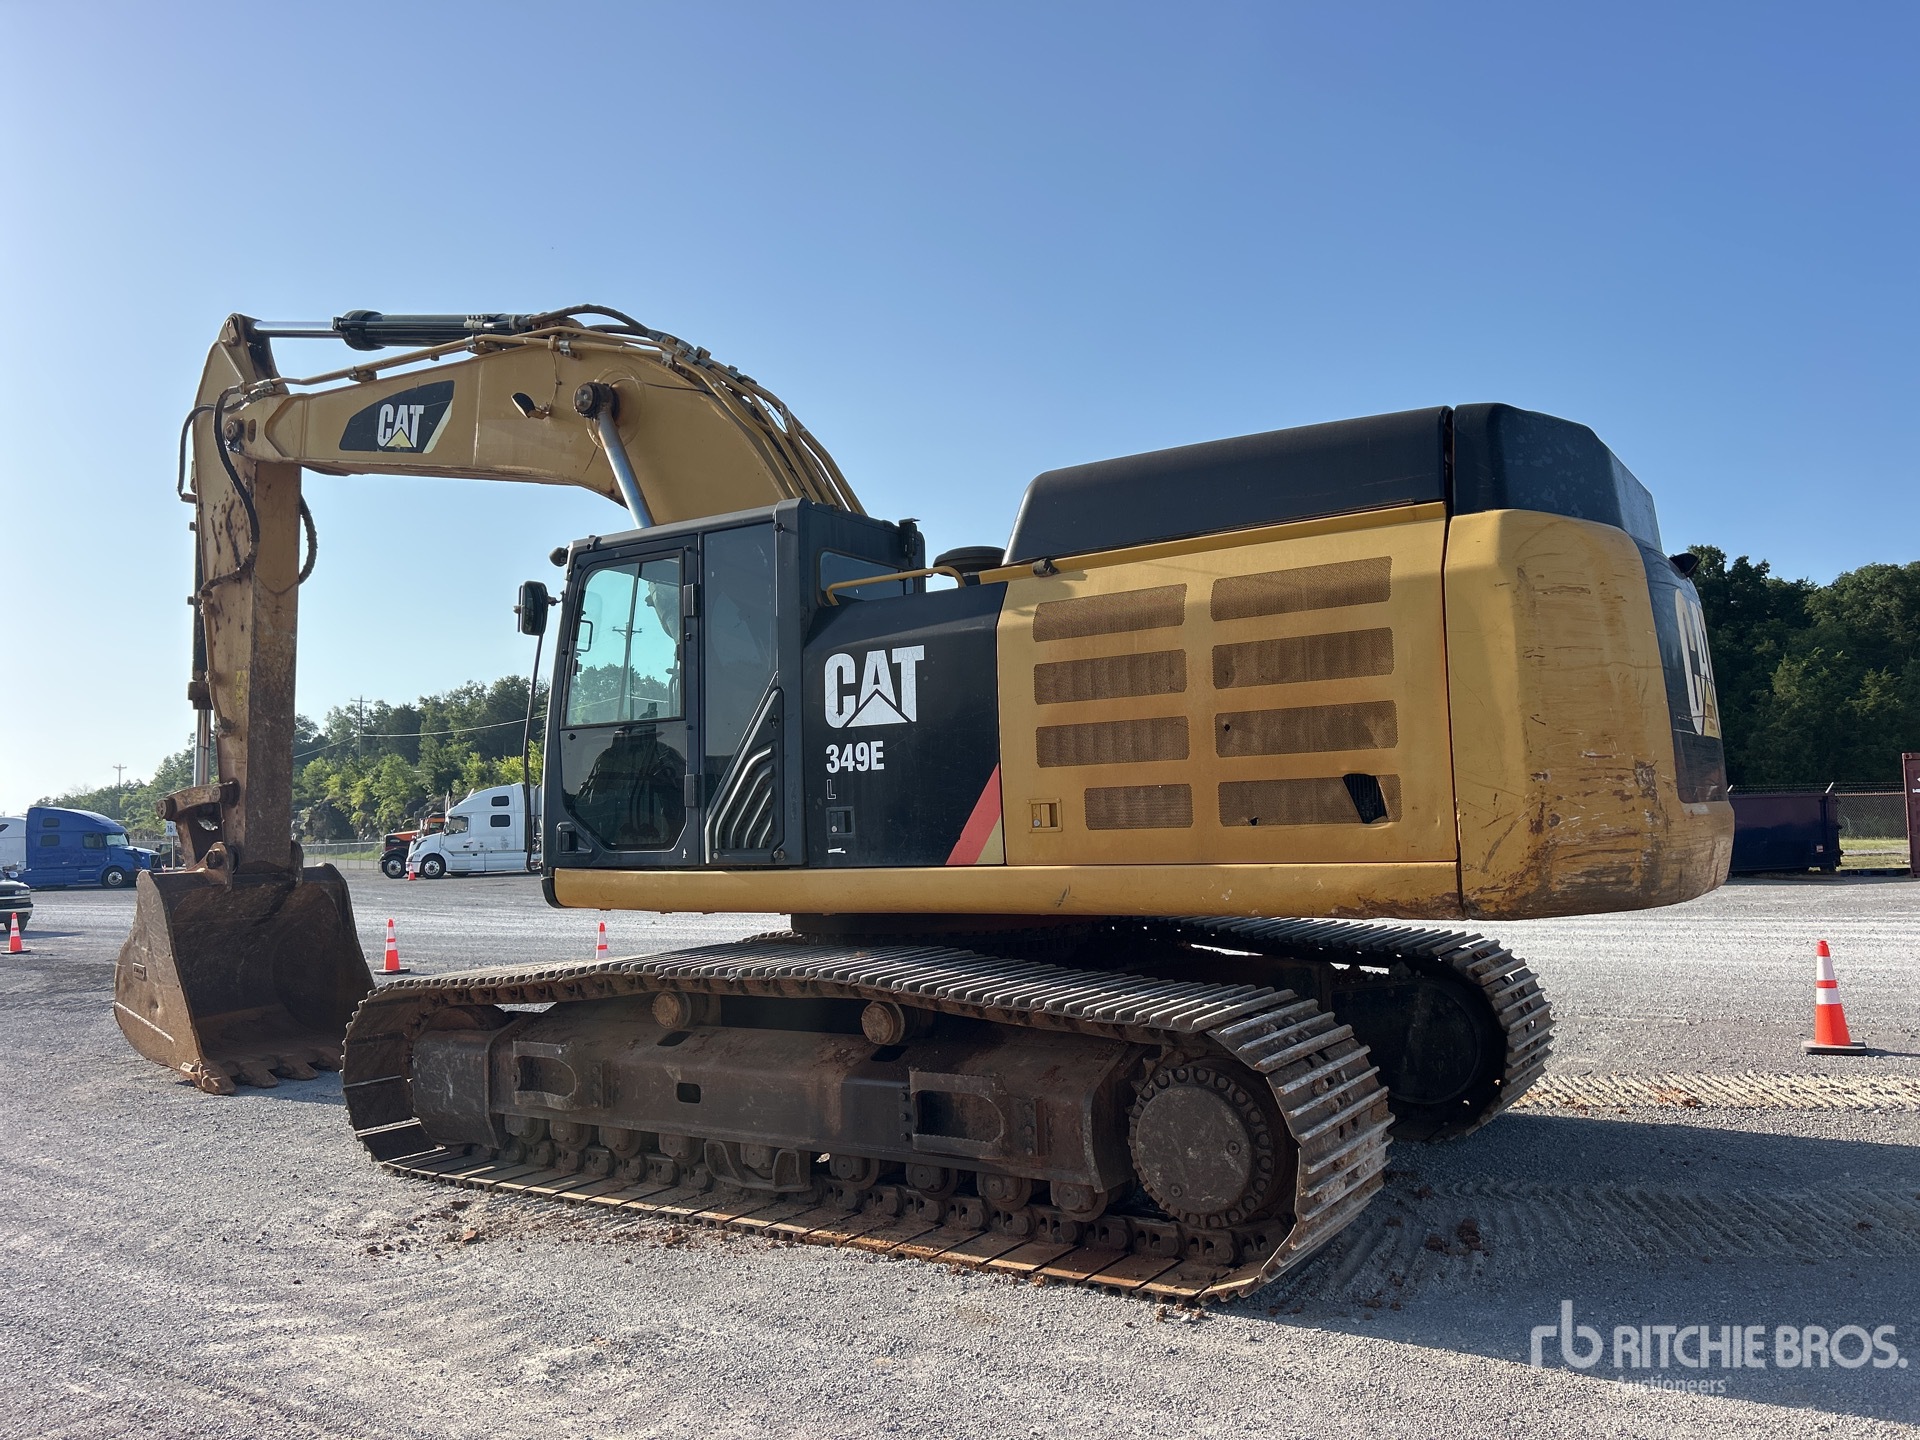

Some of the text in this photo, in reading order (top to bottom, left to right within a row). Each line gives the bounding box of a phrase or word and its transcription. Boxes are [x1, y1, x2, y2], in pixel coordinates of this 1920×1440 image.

[377, 403, 425, 448] CAT
[824, 644, 925, 729] CAT
[825, 740, 885, 774] 349E
